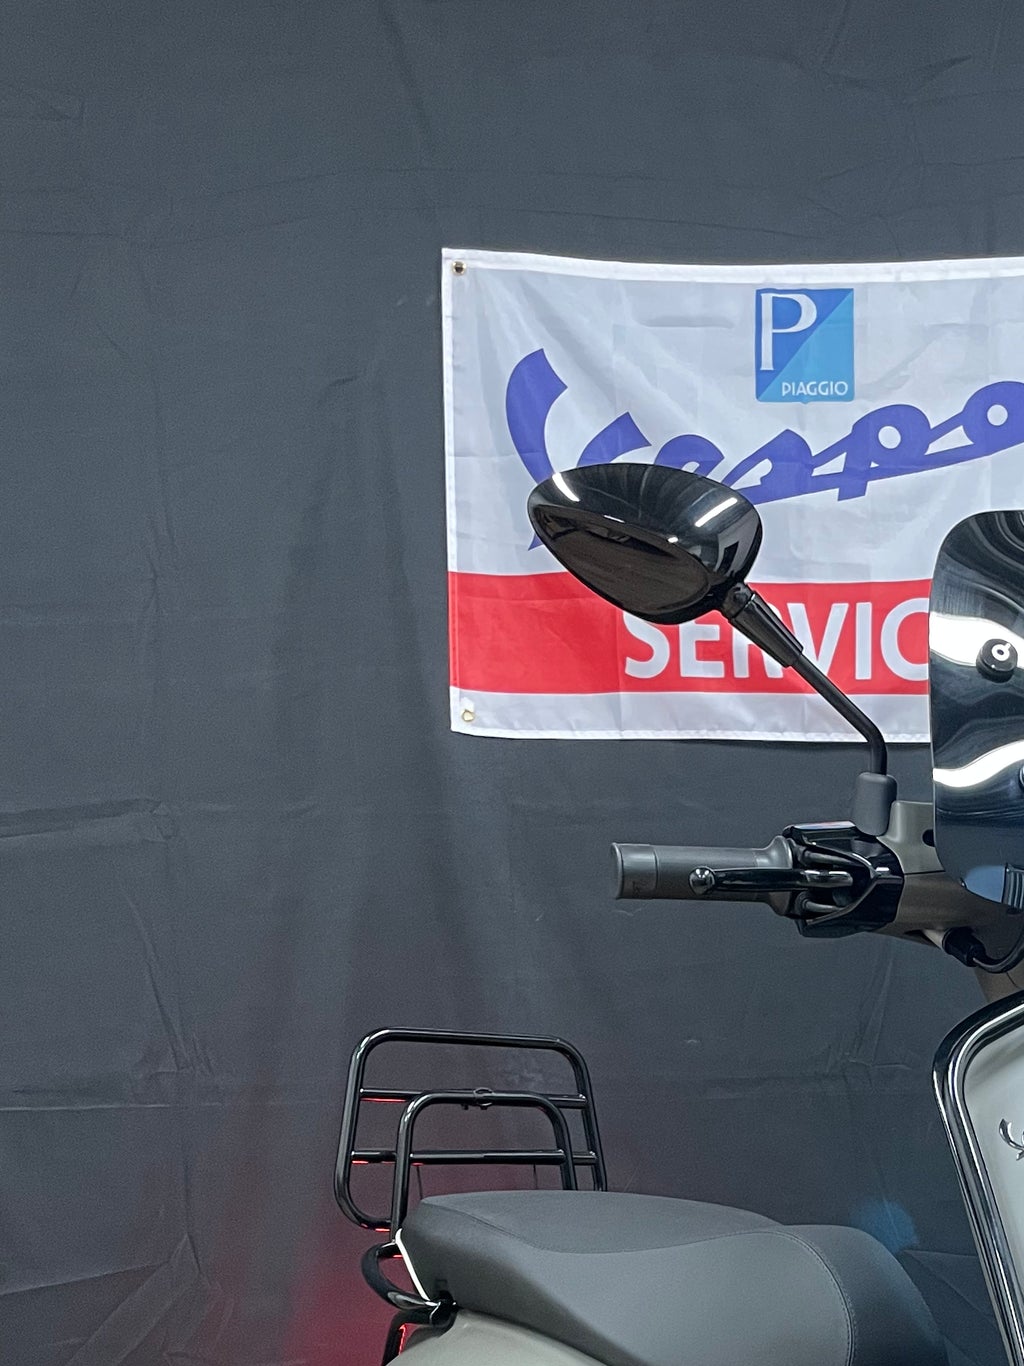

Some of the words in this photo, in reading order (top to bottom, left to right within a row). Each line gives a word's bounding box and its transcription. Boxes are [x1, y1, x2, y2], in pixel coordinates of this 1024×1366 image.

[760, 293, 818, 371] P
[782, 381, 849, 397] PIAGGIO
[622, 597, 930, 681] SERVIC
